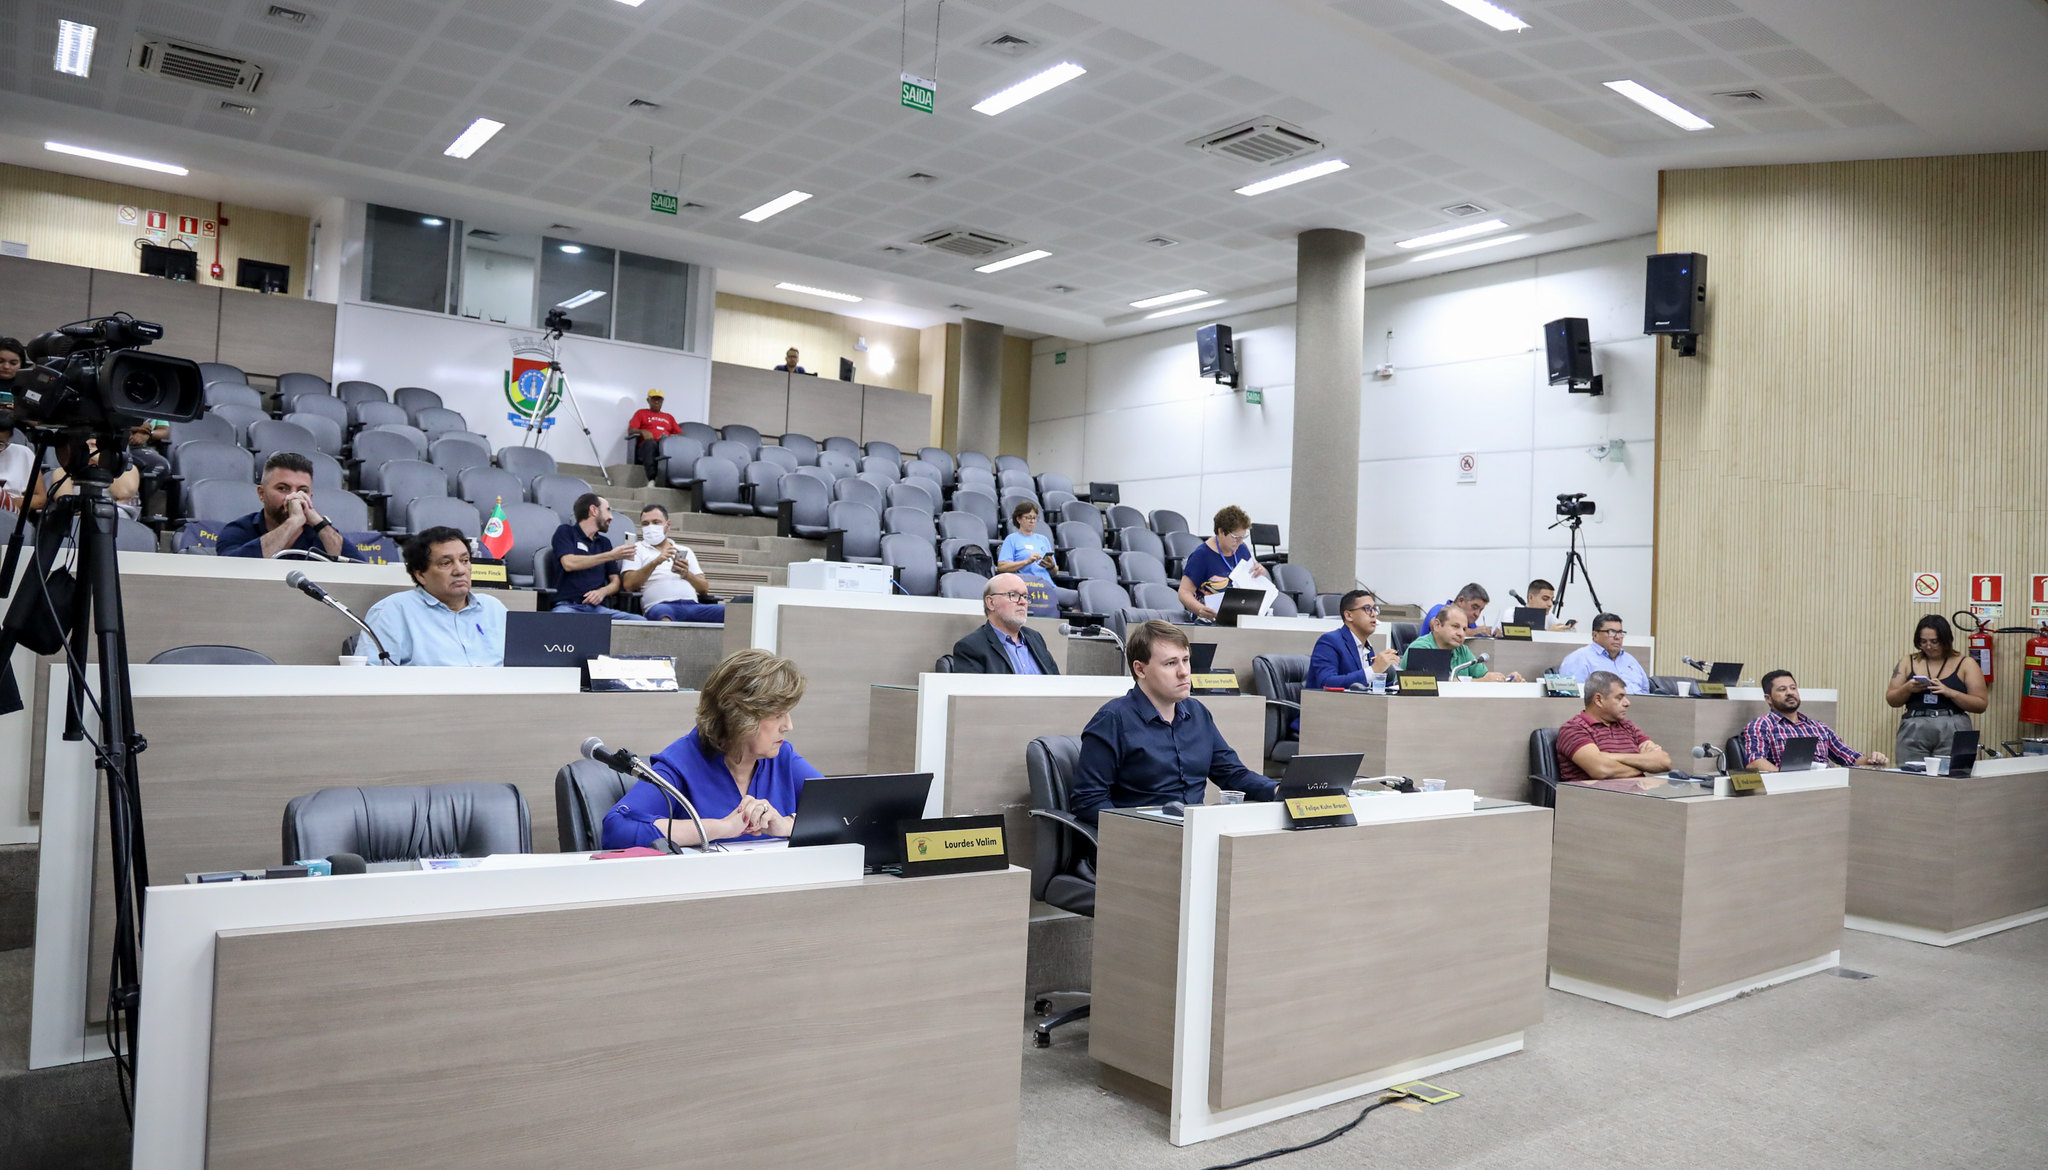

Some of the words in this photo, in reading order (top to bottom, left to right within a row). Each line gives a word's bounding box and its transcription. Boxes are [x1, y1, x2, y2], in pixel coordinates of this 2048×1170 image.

[903, 84, 932, 107] SAÍDA
[543, 644, 575, 653] VAIO
[1307, 782, 1328, 790] VAIO
[945, 839, 975, 849] Lourdes
[975, 837, 997, 847] Valim
